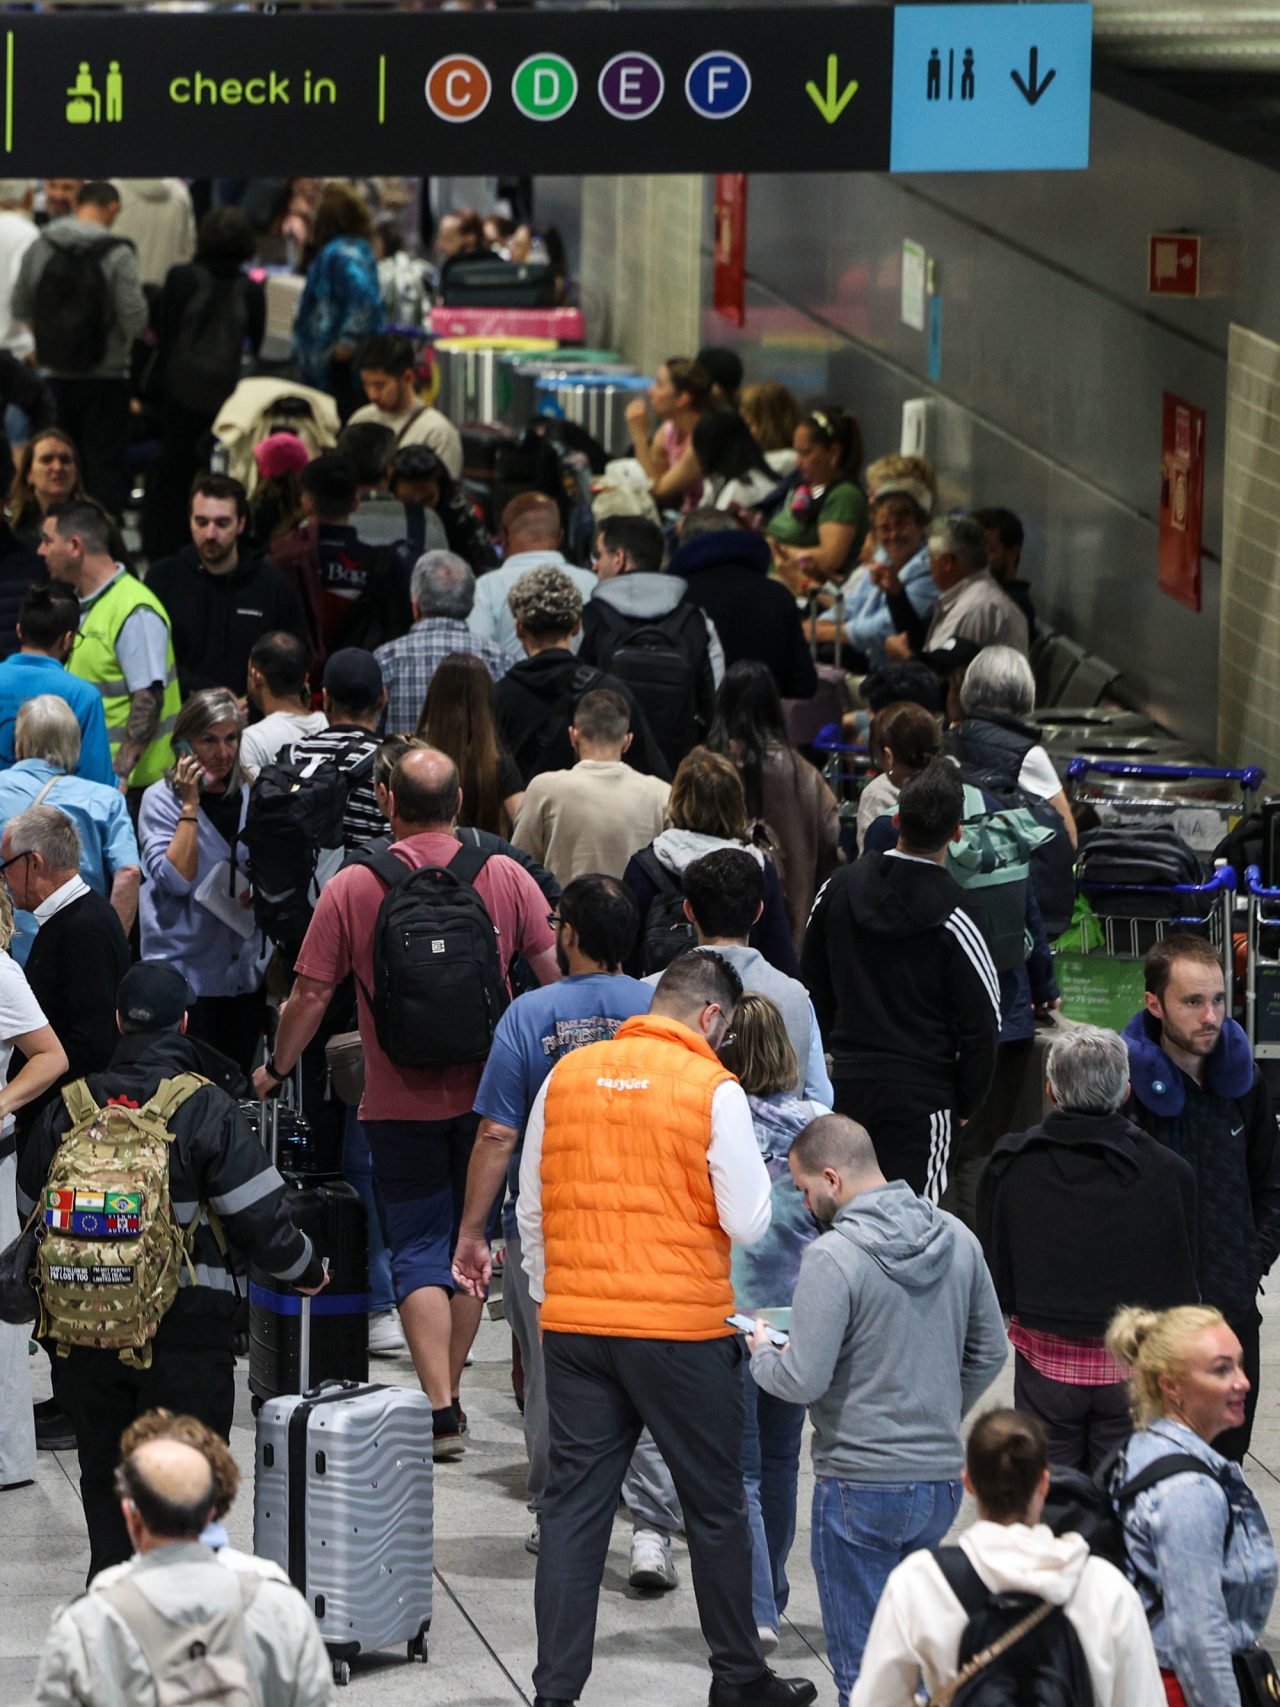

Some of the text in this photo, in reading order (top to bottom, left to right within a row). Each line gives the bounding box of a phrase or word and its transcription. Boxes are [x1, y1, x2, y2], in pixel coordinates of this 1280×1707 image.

[169, 71, 336, 104] check in
[445, 66, 731, 107] C D E F
[60, 1272, 75, 1281] LOST
[76, 1274, 89, 1282] TOO
